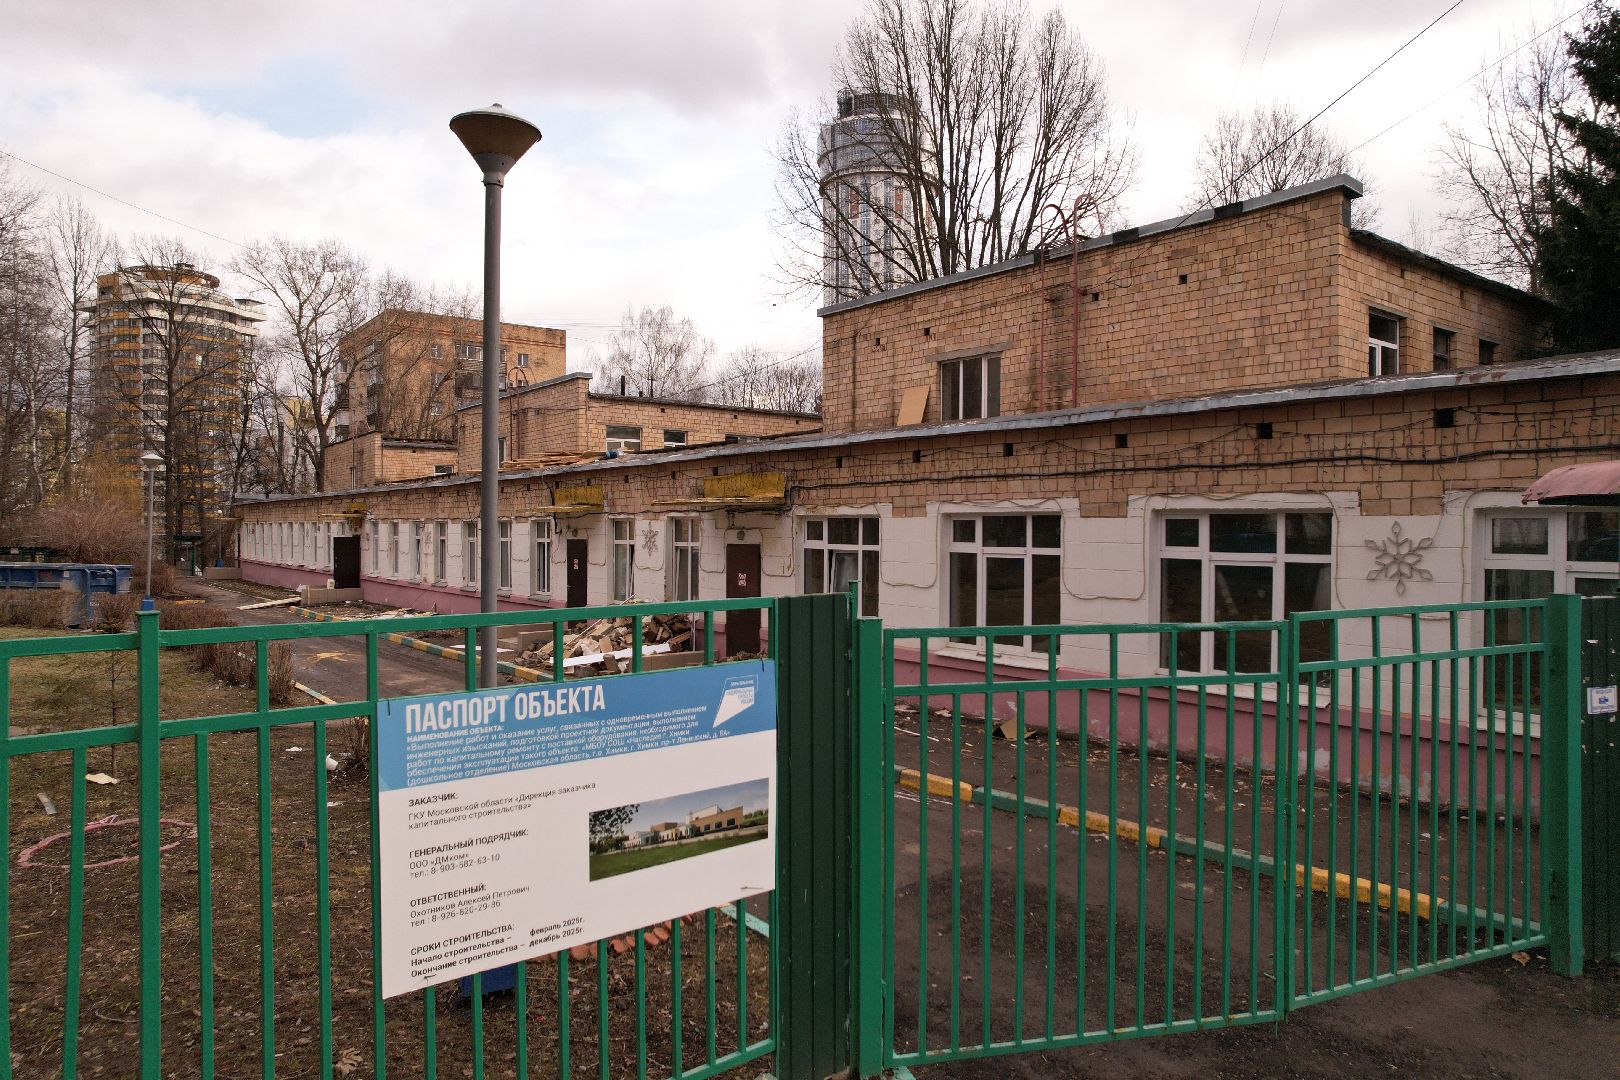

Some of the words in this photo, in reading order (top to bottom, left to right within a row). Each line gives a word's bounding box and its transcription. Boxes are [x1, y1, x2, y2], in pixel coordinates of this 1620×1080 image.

[405, 694, 509, 734] ПАСПОРТ
[514, 684, 605, 720] ОБЪЕКТА
[406, 729, 468, 743] НАИМЕНОВАНИЕ
[470, 724, 504, 734] ОБЪЕКТА:
[406, 746, 462, 761] инженерных
[510, 732, 560, 746] подготовкой
[560, 727, 598, 739] проектной
[652, 714, 695, 725] выполнением
[407, 737, 462, 752] «Выполнение
[465, 734, 488, 745] работ
[498, 729, 534, 739] оказание
[536, 726, 558, 735] услуг,
[560, 720, 599, 730] связанных
[606, 712, 662, 726] одновременным
[406, 758, 431, 769] работ
[446, 748, 504, 764] капитальному
[506, 744, 539, 755] ремонту
[547, 736, 585, 748] поставкой
[406, 762, 461, 777] обеспечения
[464, 754, 518, 769] эксплуатации
[521, 750, 546, 760] такого
[582, 741, 606, 751] «МБОУ
[607, 738, 624, 747] СОШ
[407, 770, 463, 786] (дошкольное
[465, 763, 509, 777] отделение)
[511, 756, 558, 769] Московская
[408, 792, 458, 807] ЗАКАЗЧИК:
[408, 810, 425, 821] ГКУ
[427, 800, 478, 817] Московской
[480, 795, 512, 808] области
[515, 788, 555, 803] «Дирекция
[558, 782, 595, 794] заказчика
[408, 814, 466, 830] капитального
[468, 802, 531, 820] строительства»
[409, 837, 473, 858] ГЕНЕРАЛЬНЫЙ
[475, 828, 528, 846] ПОДРЯДЧИК:
[409, 859, 428, 870] ООО
[410, 882, 486, 907] ОТВЕТСТВЕННЫЙ:
[410, 901, 455, 918] Охотников
[458, 893, 490, 907] Алексей
[492, 884, 529, 900] Петрович
[411, 941, 440, 956] СРОКИ
[442, 923, 514, 947] СТРОИТЕЛЬСТВА:
[411, 952, 442, 966] Начало
[444, 937, 504, 959] строительства
[529, 921, 561, 937] февраль
[411, 959, 456, 978] Окончание
[458, 944, 517, 966] строительства
[528, 932, 560, 947] декабрь
